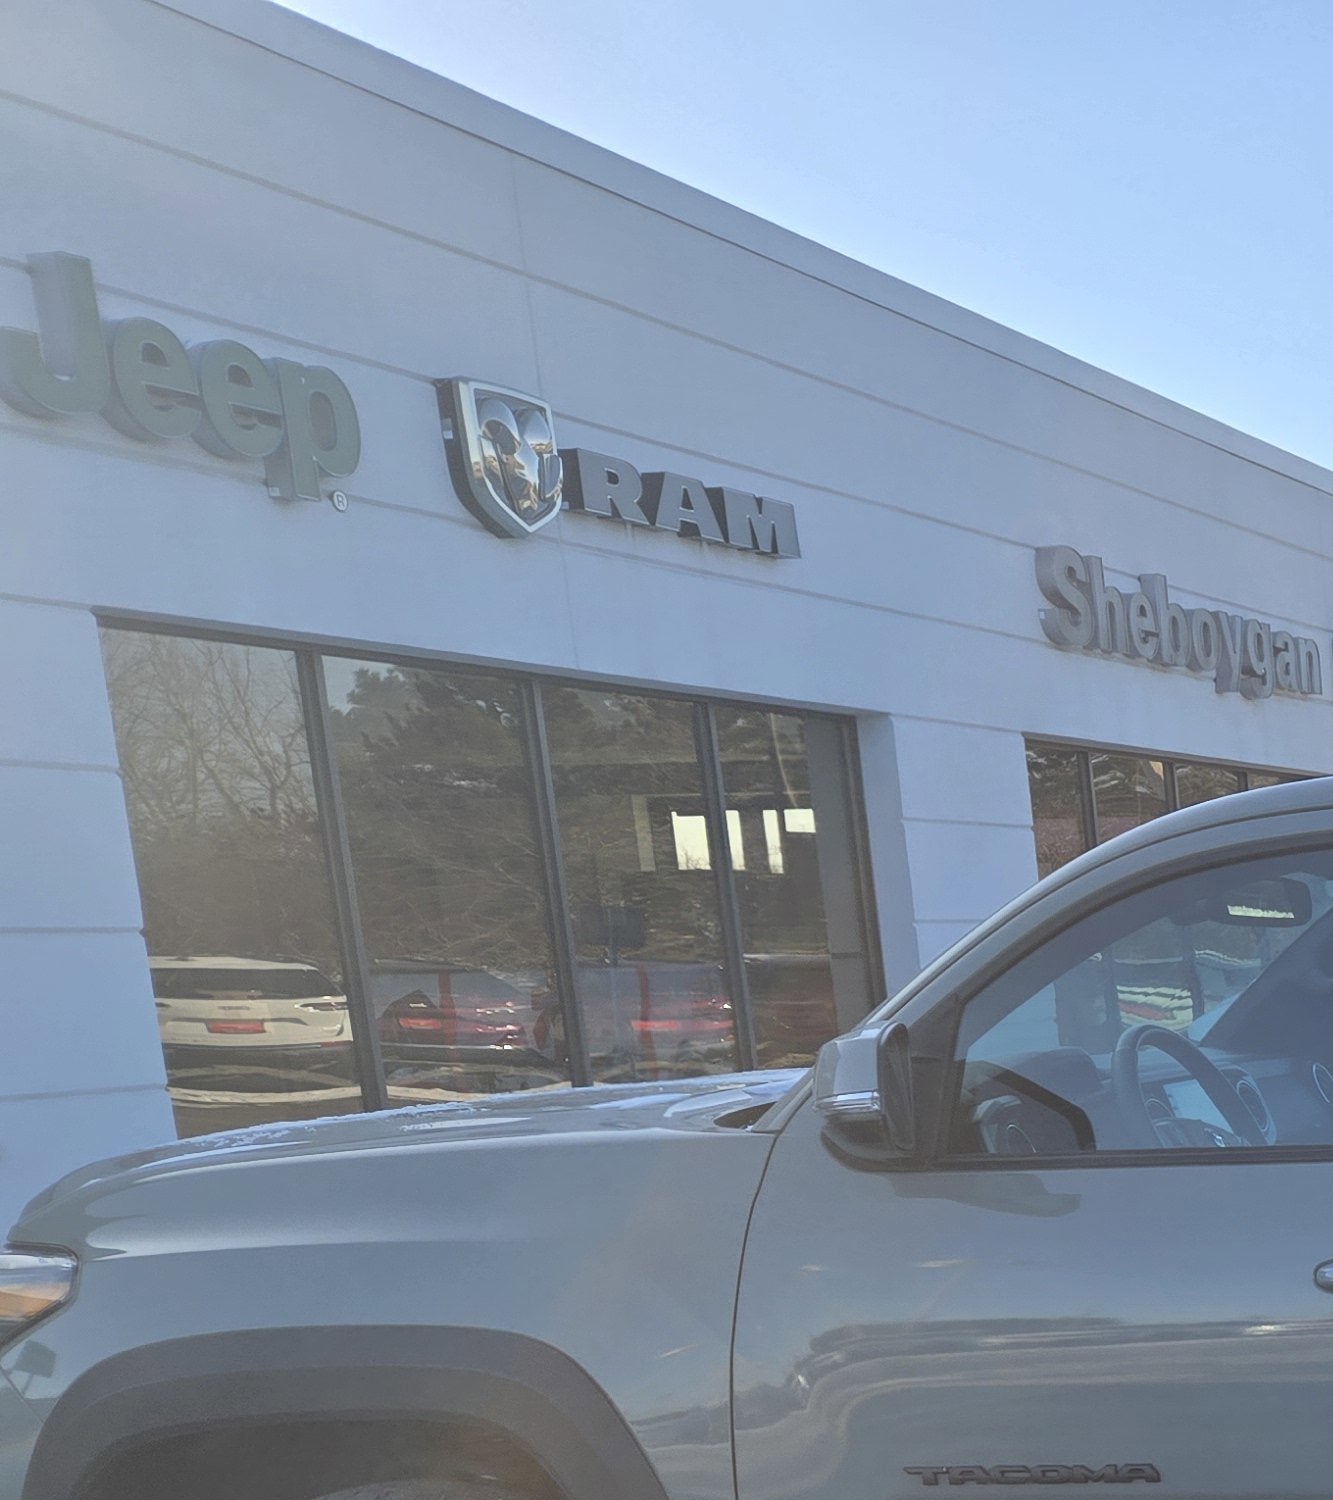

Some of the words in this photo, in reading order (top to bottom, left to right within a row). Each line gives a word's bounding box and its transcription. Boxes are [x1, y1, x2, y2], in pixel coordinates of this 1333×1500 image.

[0, 251, 361, 503] Jeep
[558, 447, 801, 559] RAM
[1035, 544, 1324, 699] Sheboygan
[903, 1463, 1162, 1486] TACOMA
